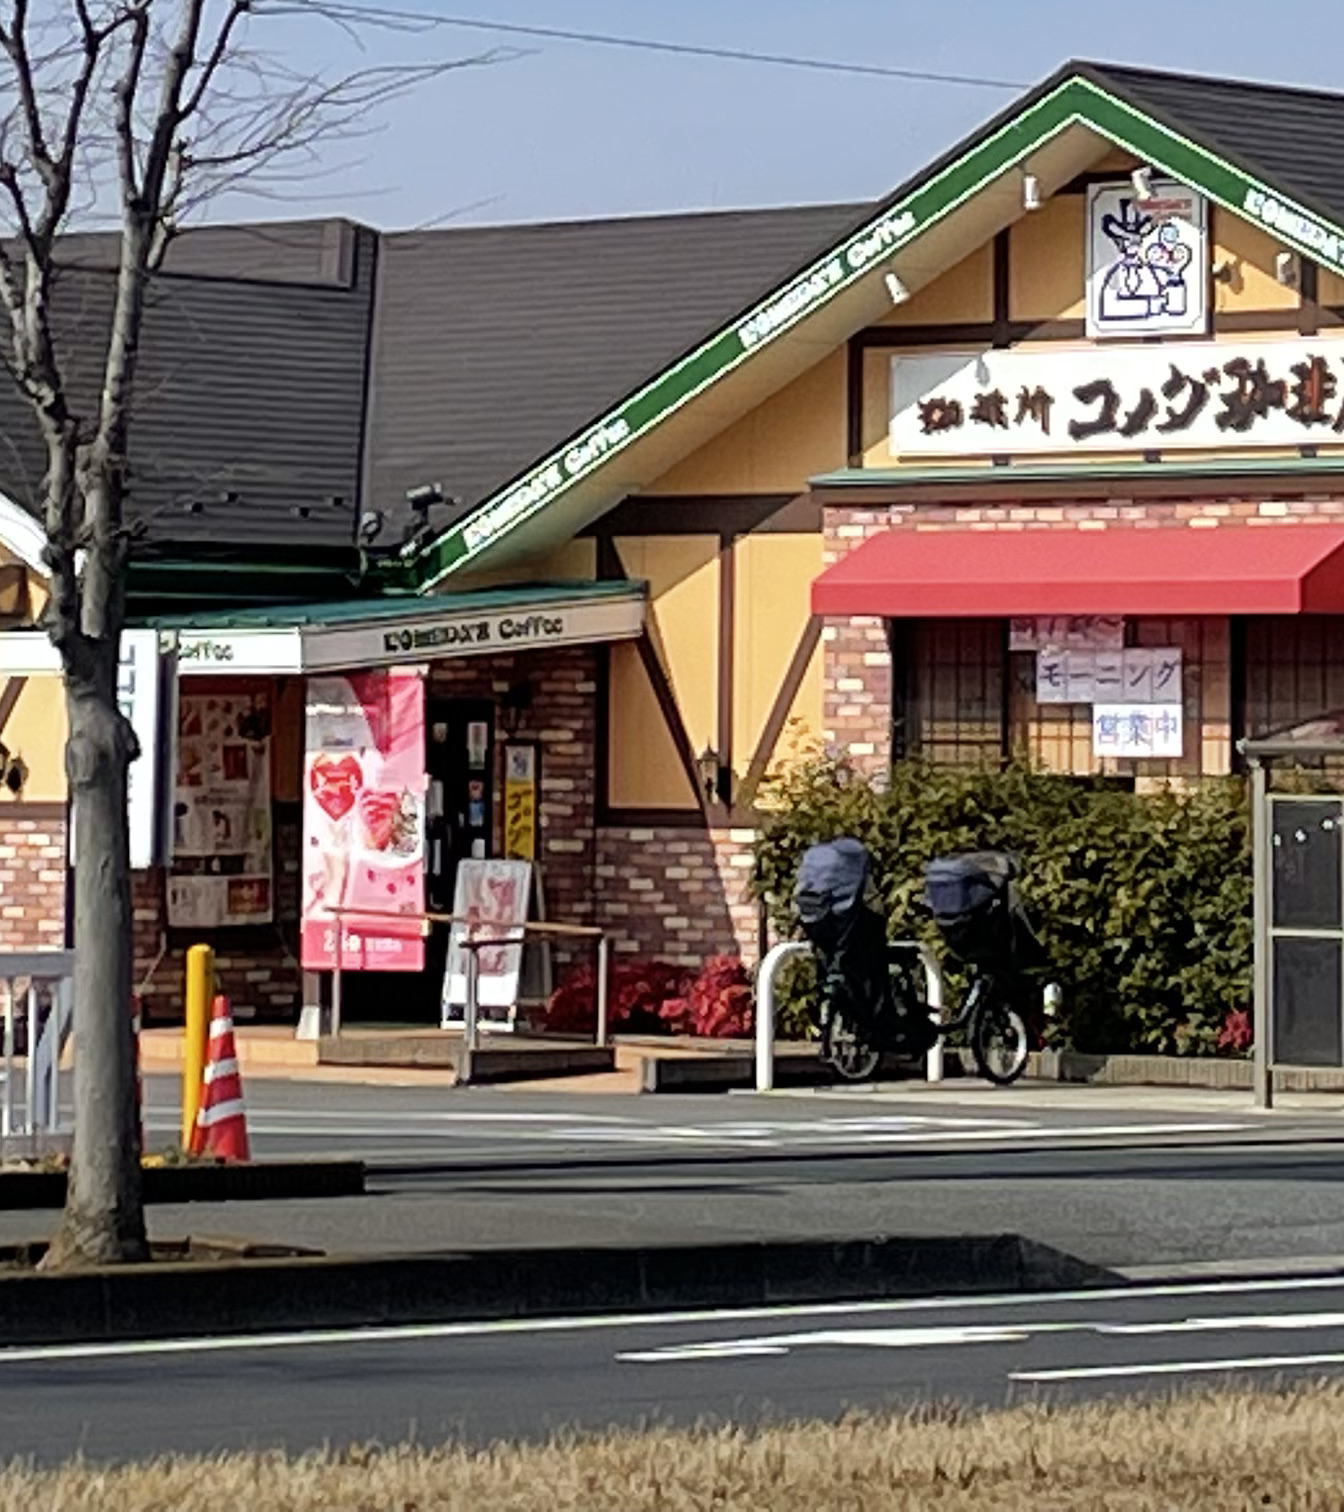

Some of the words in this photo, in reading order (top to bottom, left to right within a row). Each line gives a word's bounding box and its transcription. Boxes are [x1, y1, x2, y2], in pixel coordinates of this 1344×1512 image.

[178, 640, 234, 662] offee
[1039, 660, 1177, 689] モーニング
[1096, 710, 1178, 746] 営業中
